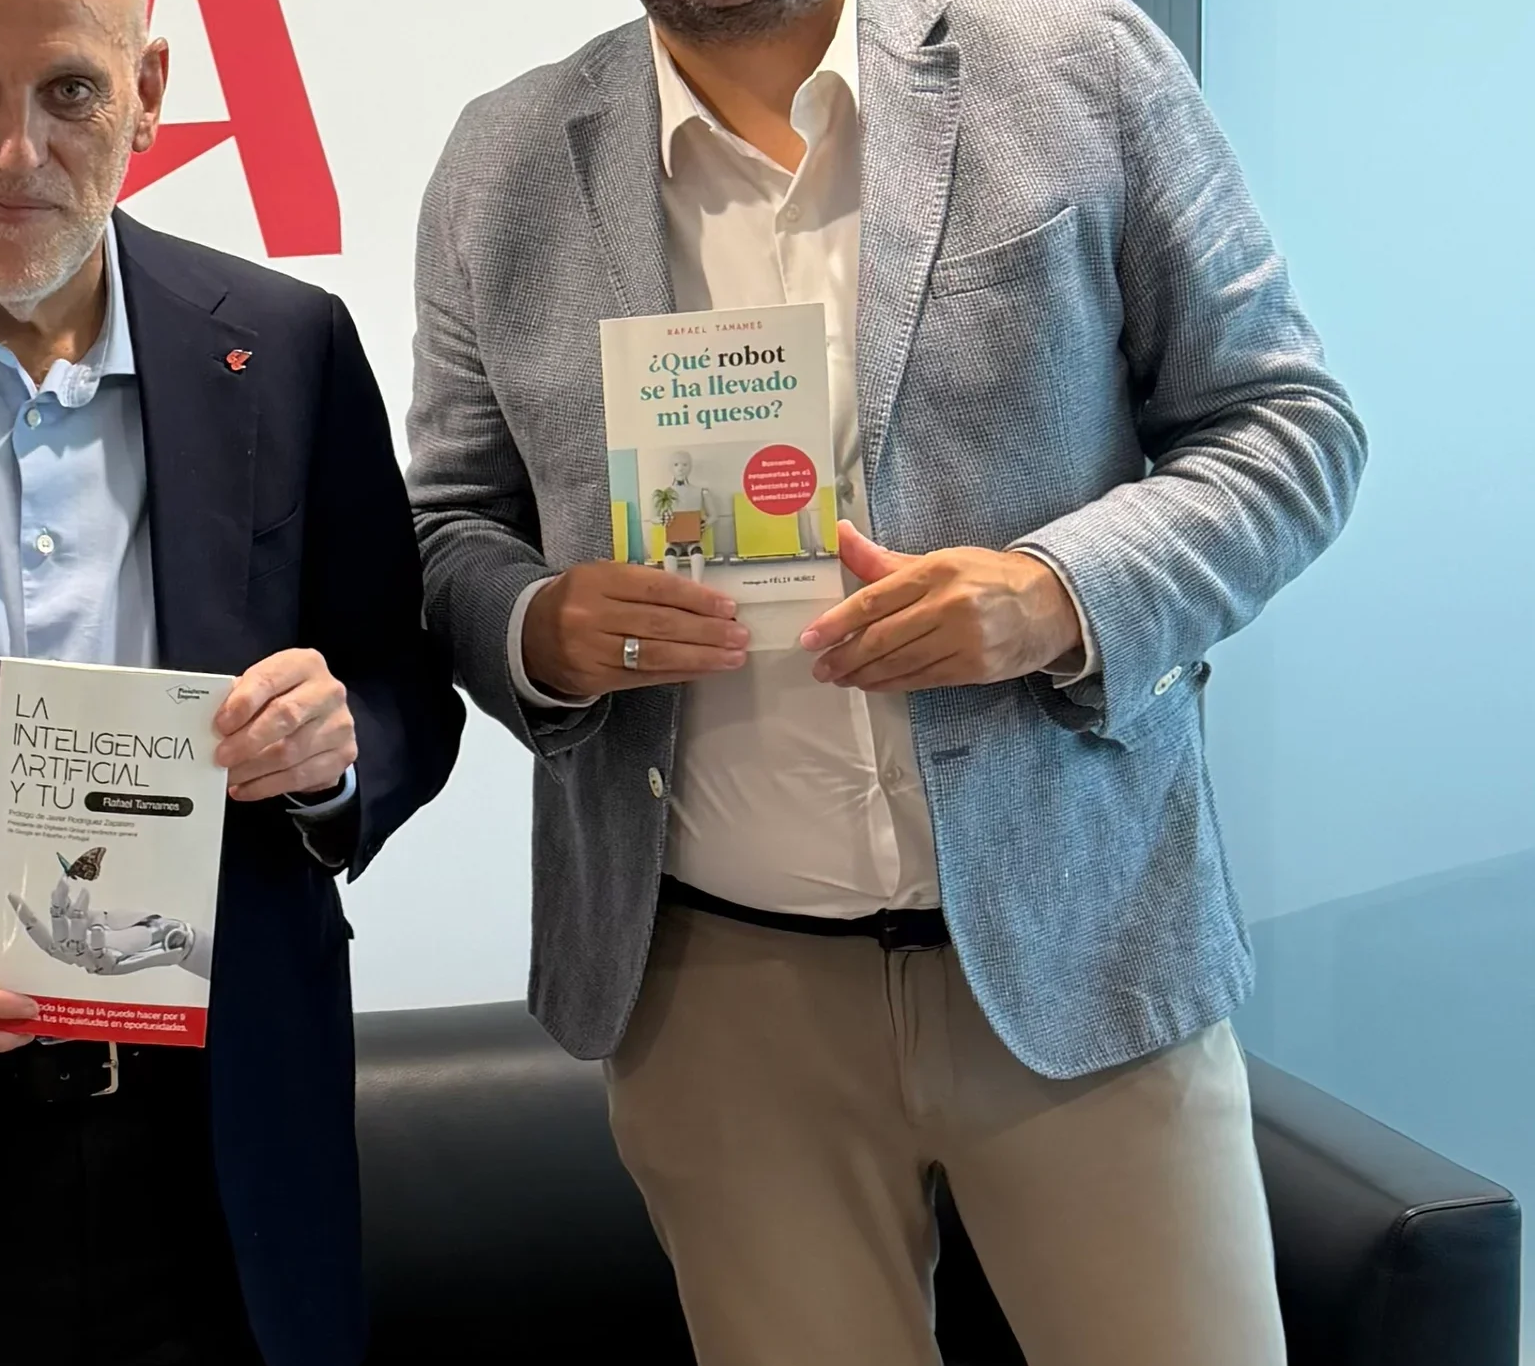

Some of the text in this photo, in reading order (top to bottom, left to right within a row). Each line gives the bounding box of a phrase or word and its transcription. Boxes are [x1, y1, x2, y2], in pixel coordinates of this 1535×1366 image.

[667, 320, 763, 336] RAFAEL TAMAMES
[649, 345, 786, 376] ¿Qué robot
[640, 370, 798, 401] se ha llevado
[657, 399, 783, 430] mi queso?
[15, 694, 49, 720] LA
[13, 723, 195, 761] INTELIGENCIA
[11, 753, 150, 788] ARTIFICIAL
[10, 780, 25, 804] Y
[102, 797, 180, 811] Rafael Tamames
[67, 1006, 85, 1015] que
